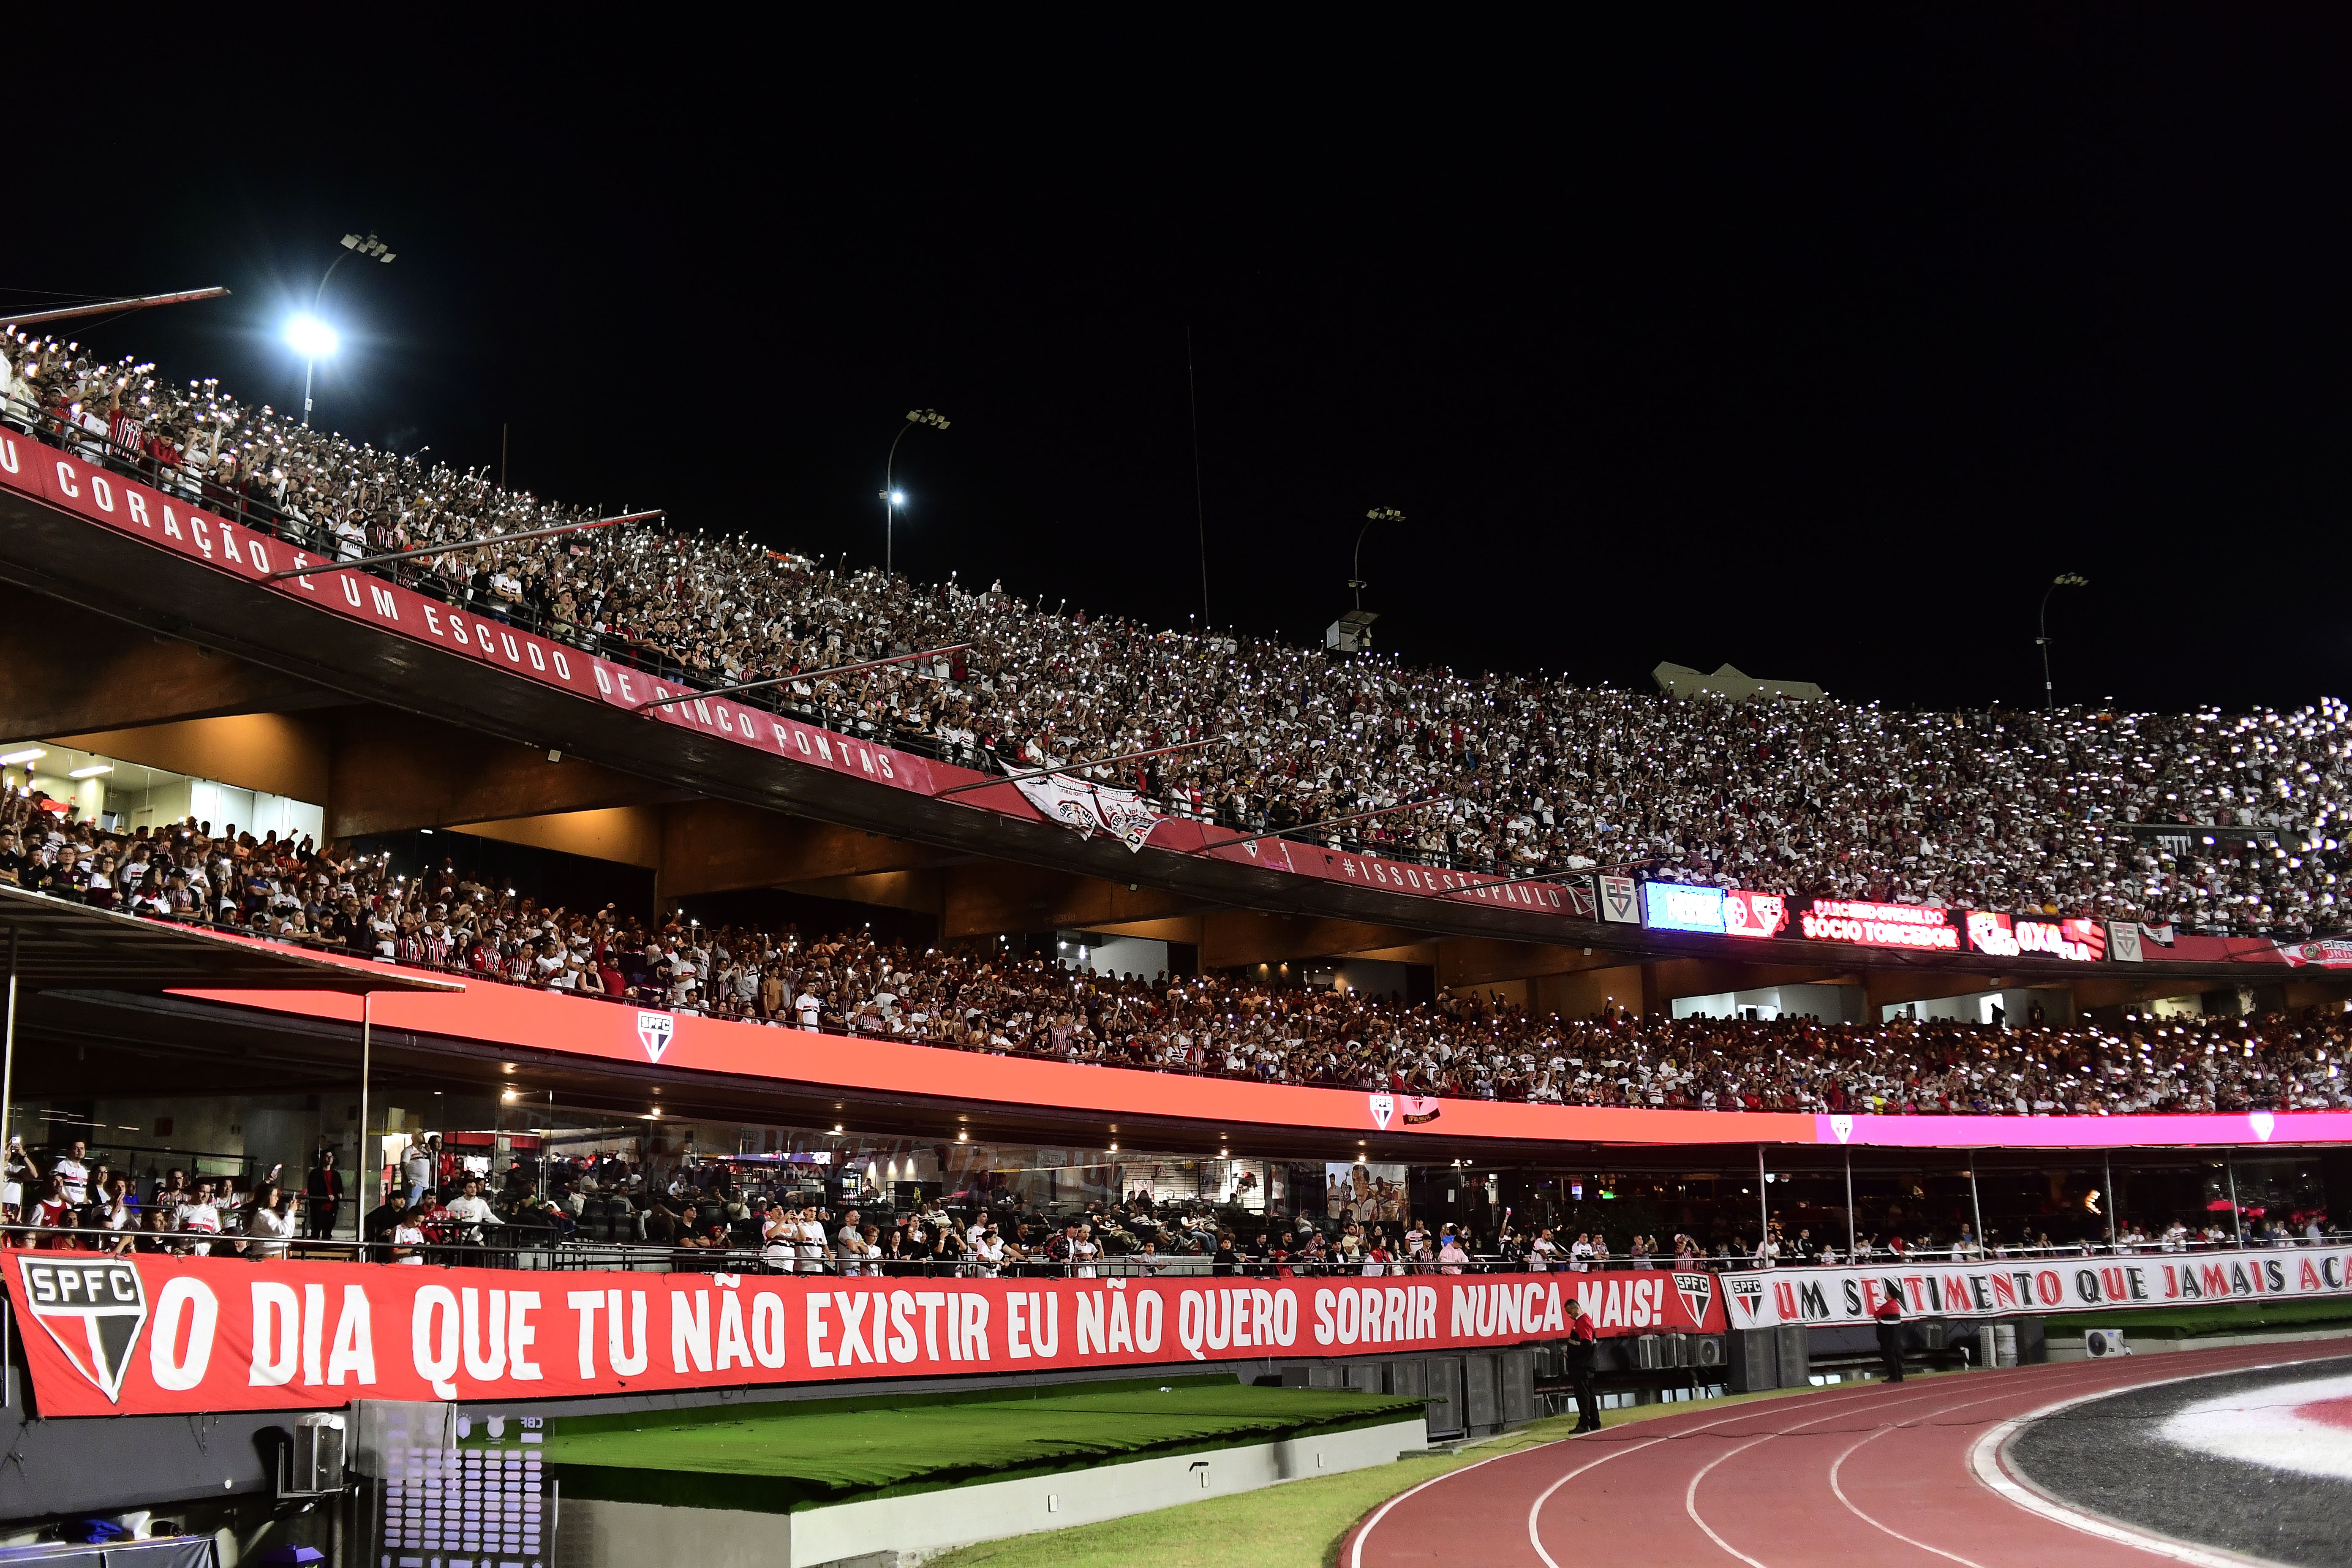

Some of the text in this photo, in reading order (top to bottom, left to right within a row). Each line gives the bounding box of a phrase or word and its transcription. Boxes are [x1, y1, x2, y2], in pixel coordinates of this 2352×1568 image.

[56, 461, 270, 574] CORAÇÃO
[293, 552, 314, 591] É
[340, 574, 398, 621] UM
[423, 604, 570, 680] ESCUDO
[593, 665, 636, 702] DE
[656, 686, 755, 739] CINCO
[773, 723, 894, 778] PONTAS
[1925, 910, 1944, 925] DO
[641, 1016, 670, 1031] SPFC
[31, 1268, 134, 1303] SPFC
[1676, 1274, 1709, 1292] SPFC
[1733, 1280, 1761, 1293] SPFC
[1774, 1279, 1831, 1322] UM
[2075, 1266, 2150, 1305] QUE
[2162, 1259, 2287, 1299] JAMAIS
[150, 1273, 1664, 1401] O DIA QUE TU NÃO EXISTIR EU NÃO QUERO SORRIR NUNCA MAIS!
